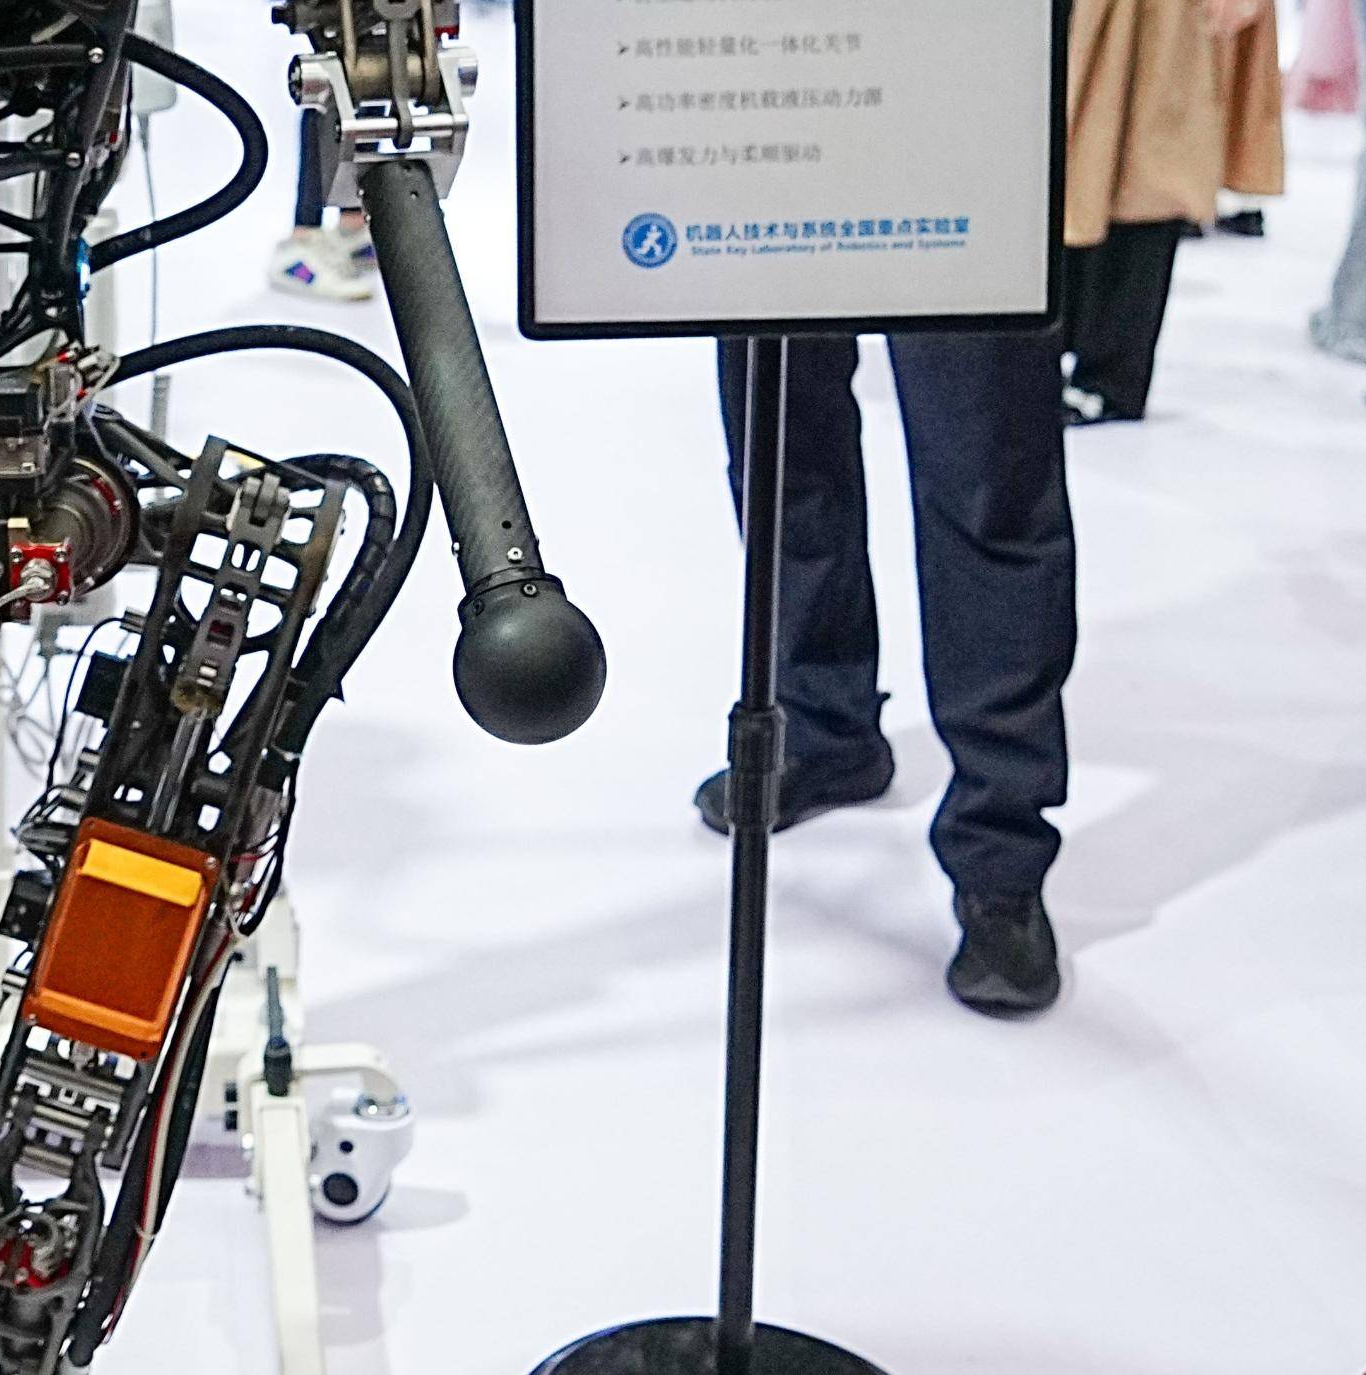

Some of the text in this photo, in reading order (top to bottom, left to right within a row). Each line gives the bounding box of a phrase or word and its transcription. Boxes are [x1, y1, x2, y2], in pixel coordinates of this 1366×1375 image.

[685, 216, 969, 243] 机器人技术与系统全国重点实验室
